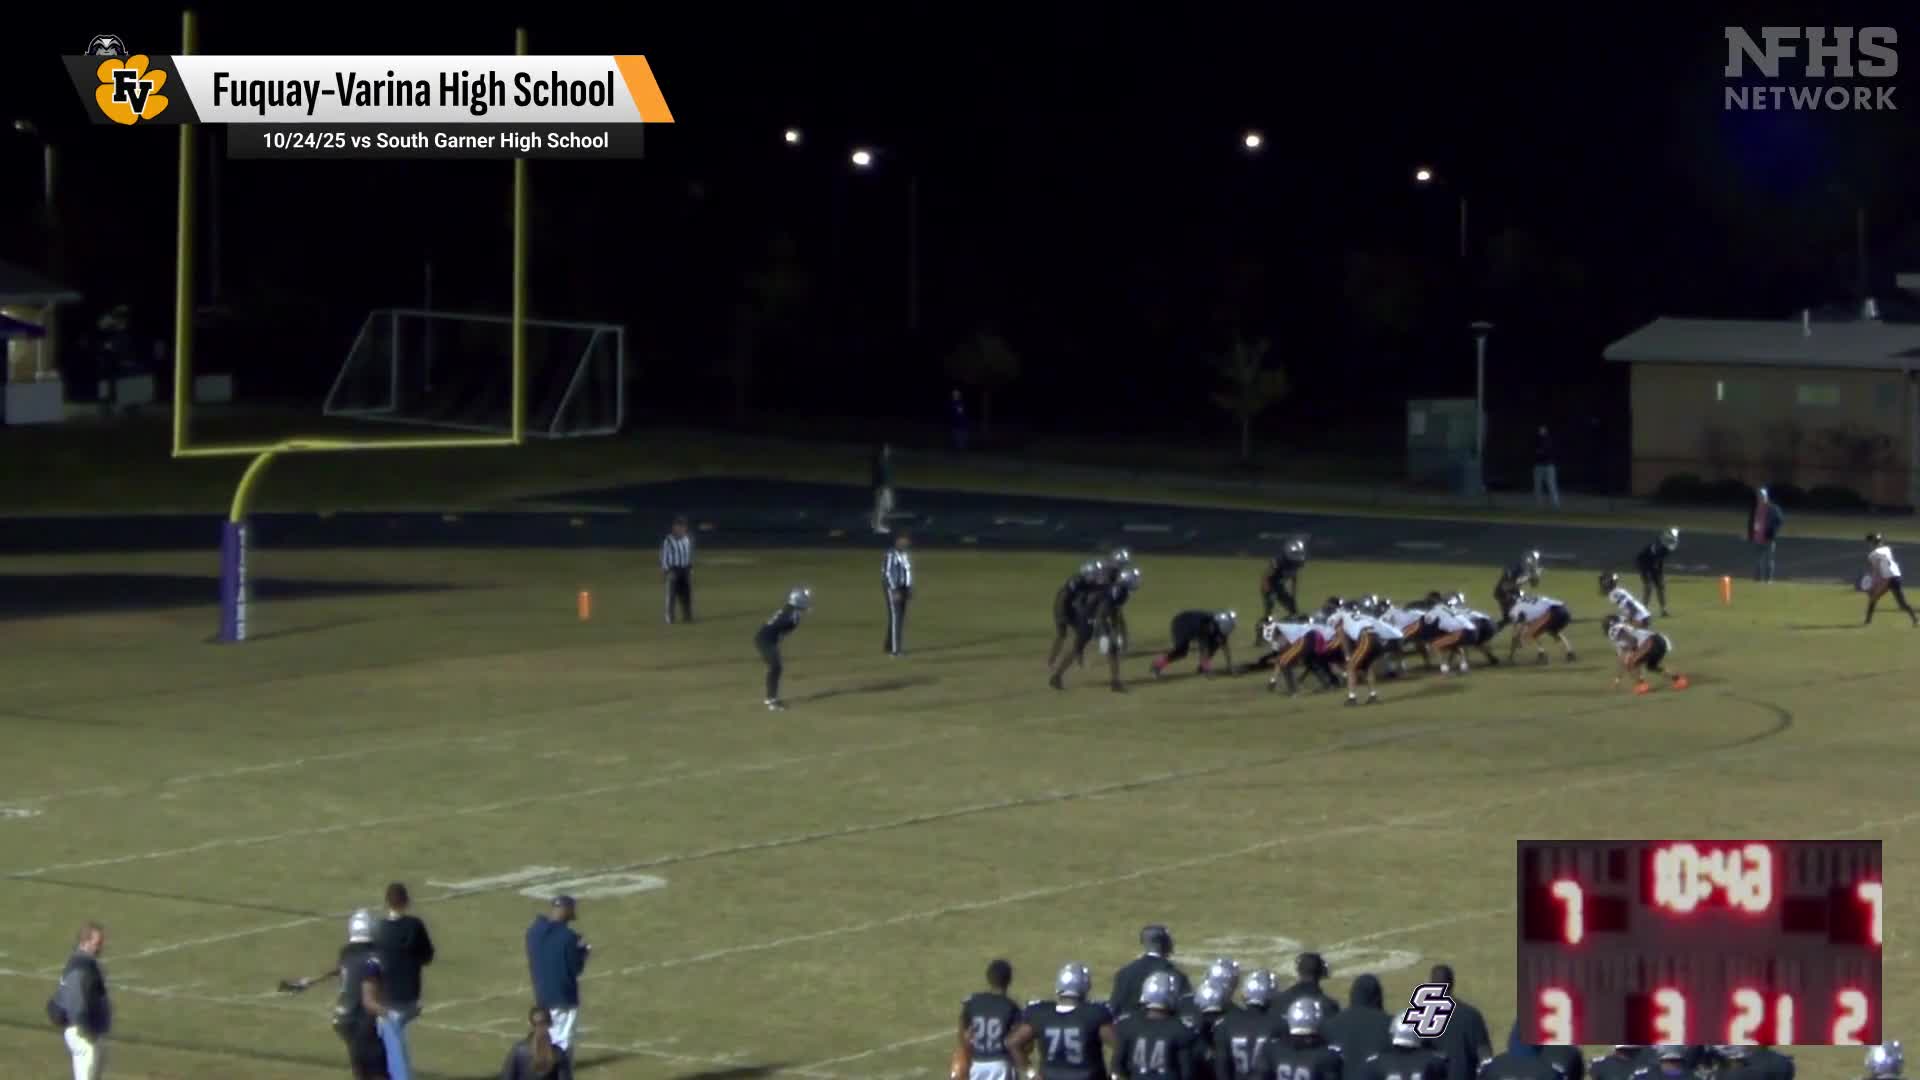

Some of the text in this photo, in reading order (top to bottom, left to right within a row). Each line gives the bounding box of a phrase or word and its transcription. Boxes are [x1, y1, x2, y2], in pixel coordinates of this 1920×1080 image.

[1553, 880, 1583, 943] 7
[1044, 1027, 1085, 1064] 75
[1132, 1037, 1167, 1075] 44
